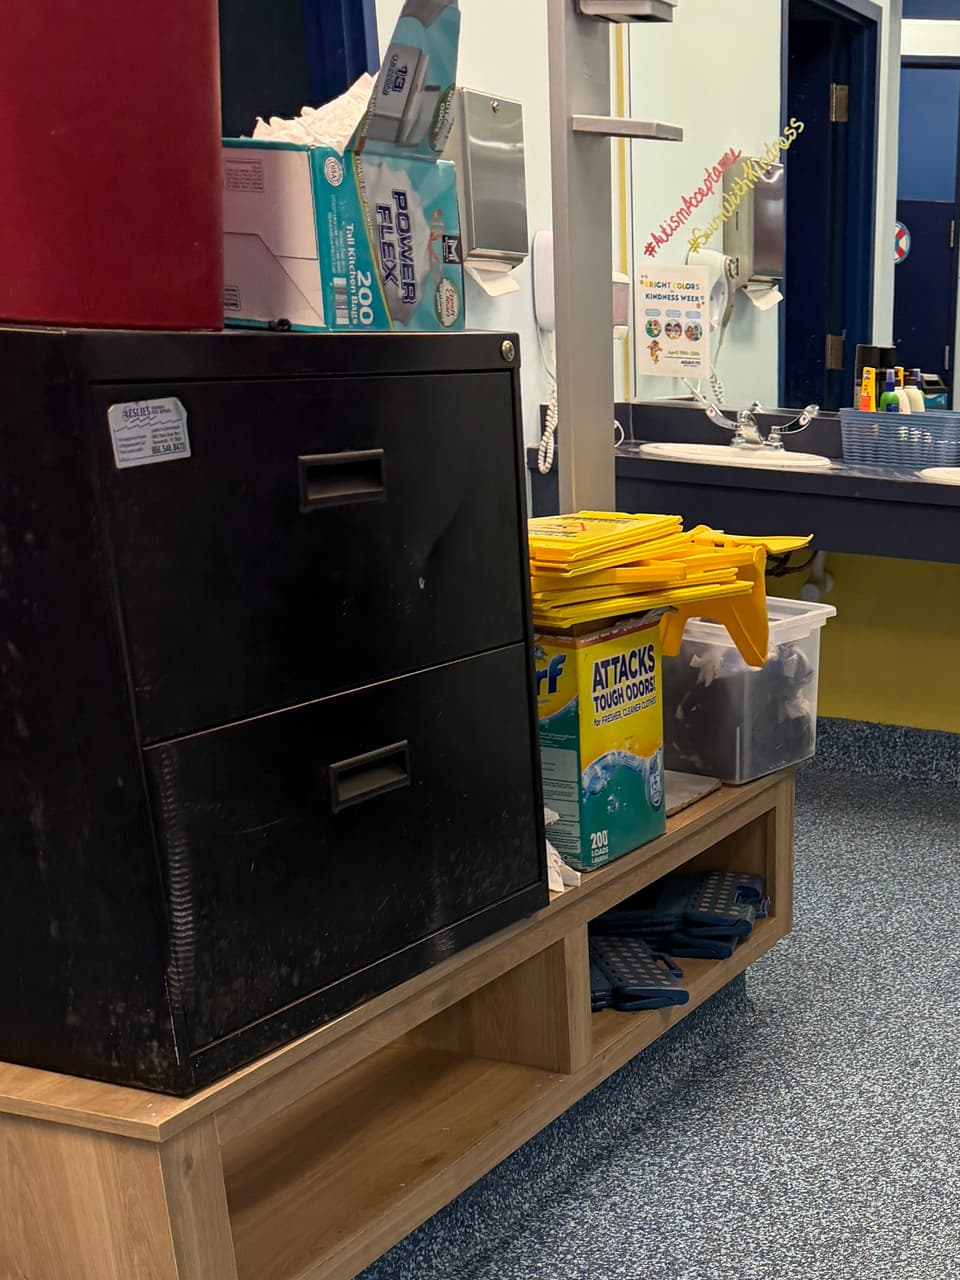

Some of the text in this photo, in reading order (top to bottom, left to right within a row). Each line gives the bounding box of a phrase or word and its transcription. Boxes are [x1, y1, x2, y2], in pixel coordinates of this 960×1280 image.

[375, 202, 399, 289] FLEX
[392, 188, 417, 305] POWER
[346, 223, 358, 325] Tall Kitchen Bags
[644, 280, 700, 290] BRIGHT COLORS
[357, 271, 374, 325] 200
[645, 293, 699, 302] KINDNESS WEEK
[535, 654, 567, 696] rf
[592, 644, 656, 694] ATTACKS
[592, 687, 625, 714] TOUGH
[593, 718, 602, 728] for
[590, 830, 608, 849] 200
